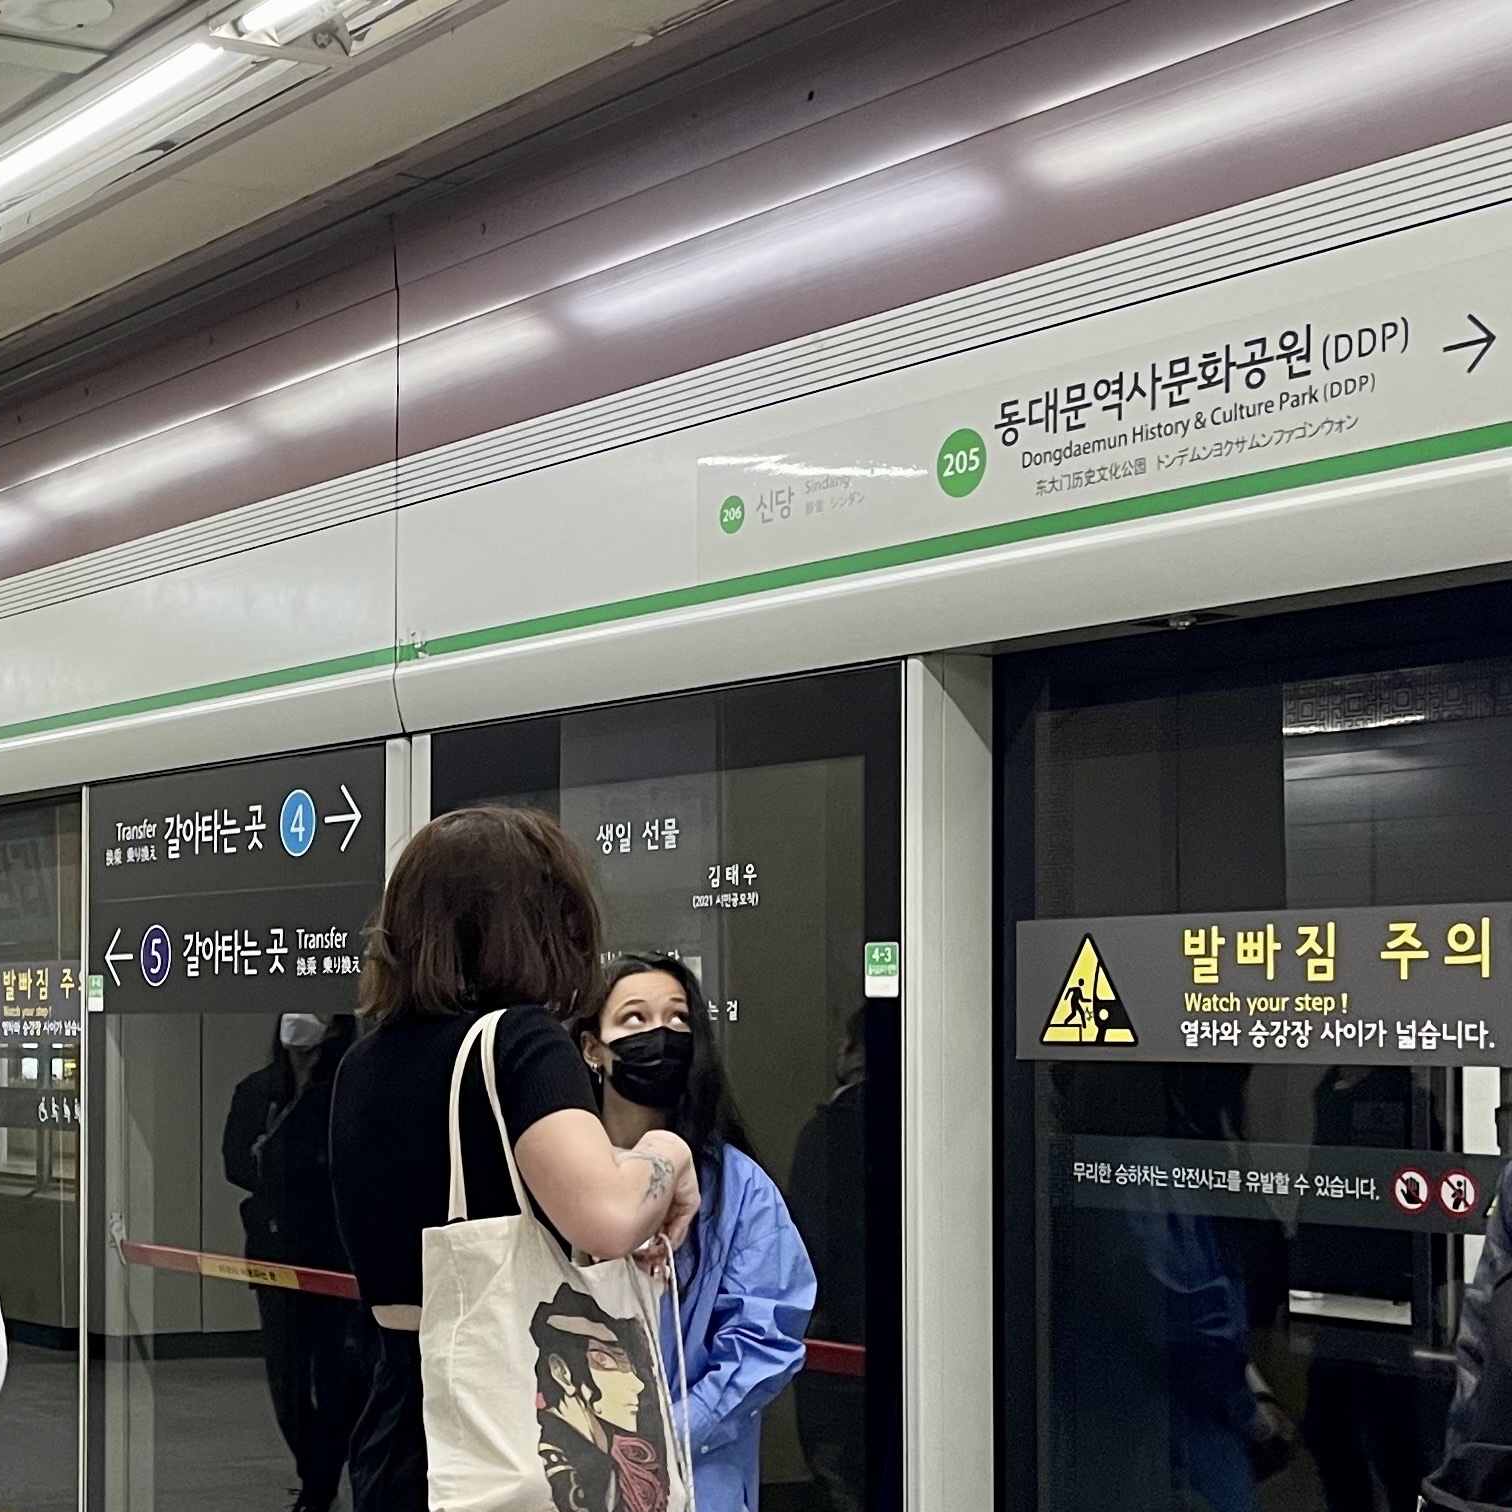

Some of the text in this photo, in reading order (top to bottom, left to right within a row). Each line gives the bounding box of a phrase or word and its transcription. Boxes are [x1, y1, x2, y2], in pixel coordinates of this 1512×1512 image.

[994, 316, 1410, 447] 동대문역사문화공원 (DDP)
[1020, 372, 1377, 469] Dongdaemun History & Culture Park (DDP)
[943, 447, 981, 478] 205
[1034, 457, 1148, 497] 东大门历史文化公园
[803, 475, 850, 495] Sindang
[722, 486, 795, 524] 206 신당
[115, 804, 305, 858] Transfer 갈아타는 곳 4
[596, 818, 680, 855] 생일 선물
[707, 863, 758, 888] 김태우
[692, 894, 713, 908] (2021
[150, 926, 348, 977] 5 갈아타는 곳 Transfer
[871, 946, 892, 963] 4-3
[1182, 917, 1492, 984] 발빠짐 주의
[2, 967, 50, 1002] 발빠짐
[1184, 991, 1241, 1013] Watch
[1246, 996, 1290, 1016] your
[1294, 993, 1336, 1016] step
[1180, 1019, 1496, 1050] 열차와 승강장 사이가 넓습니다.
[1072, 1162, 1381, 1201] 무리한 승하차는 안전사고를 유발할 수 있습니다.
